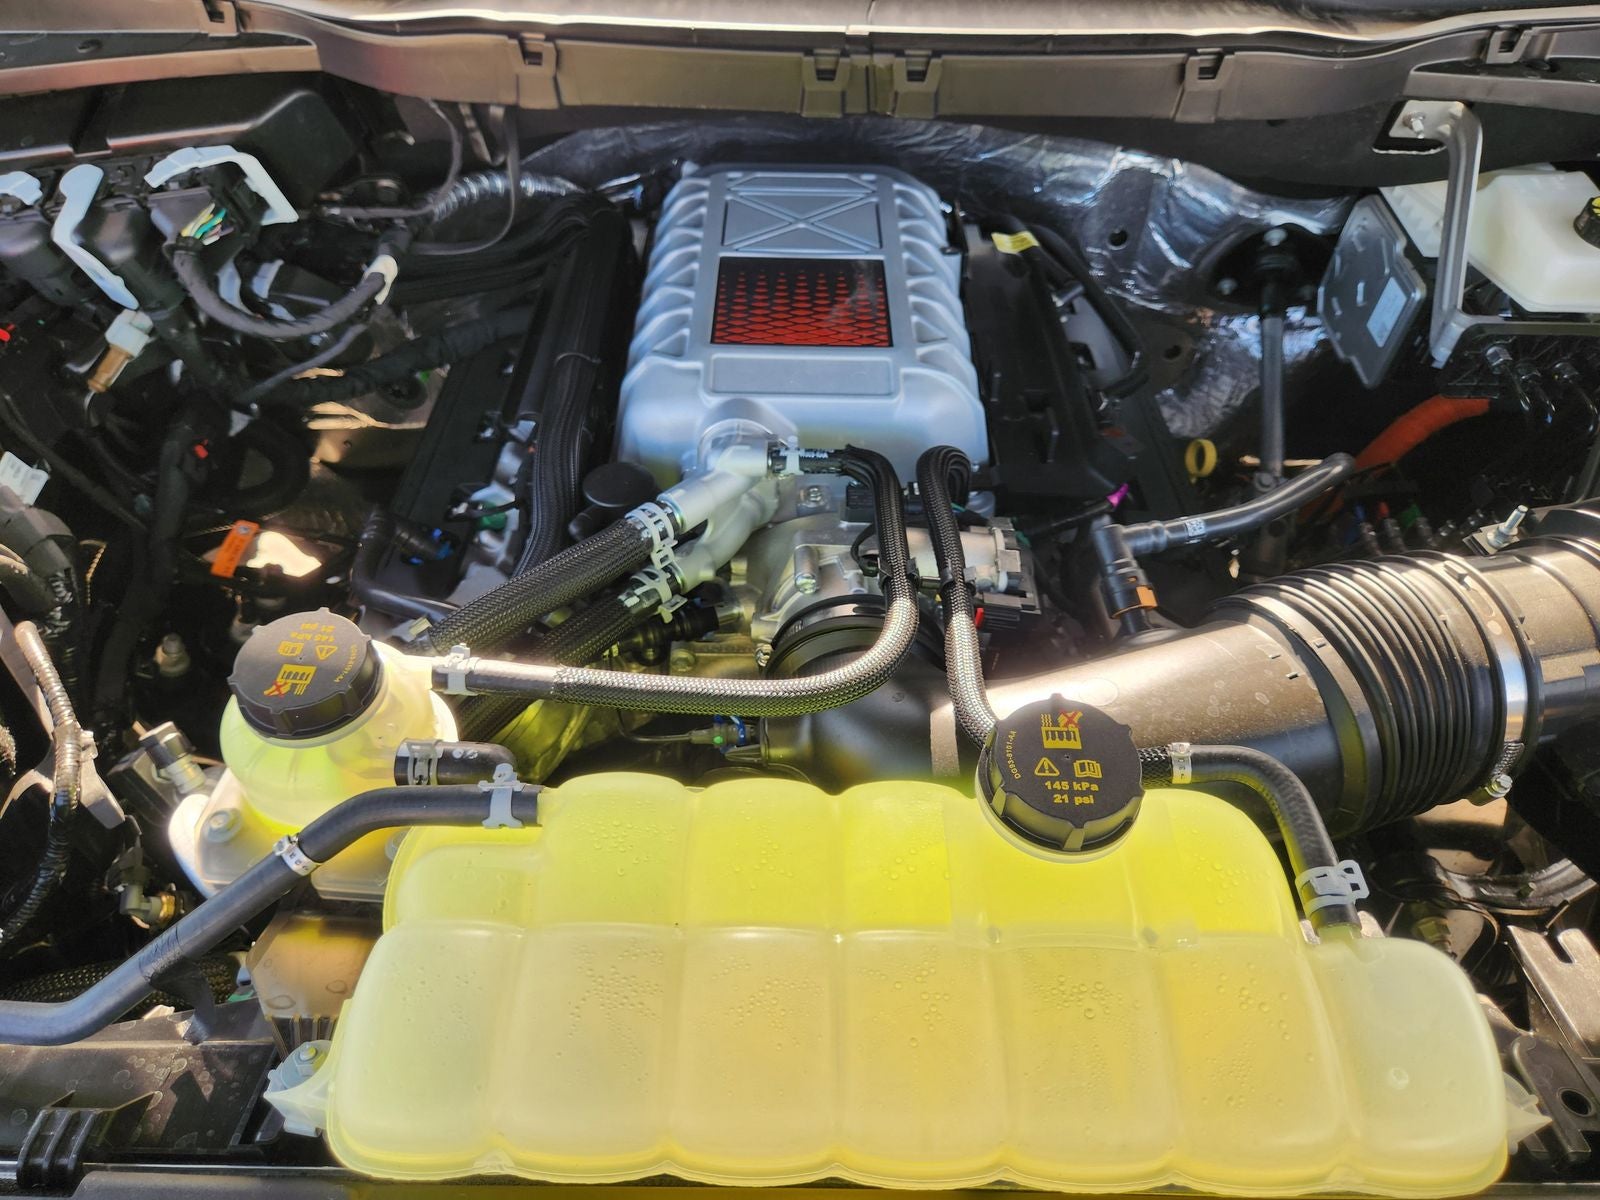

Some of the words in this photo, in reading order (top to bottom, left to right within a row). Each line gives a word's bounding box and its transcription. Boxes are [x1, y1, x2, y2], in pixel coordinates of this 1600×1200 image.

[1044, 780, 1070, 791] 145
[1072, 781, 1099, 792] kPa
[1053, 793, 1069, 804] 21
[1074, 794, 1094, 805] psi
